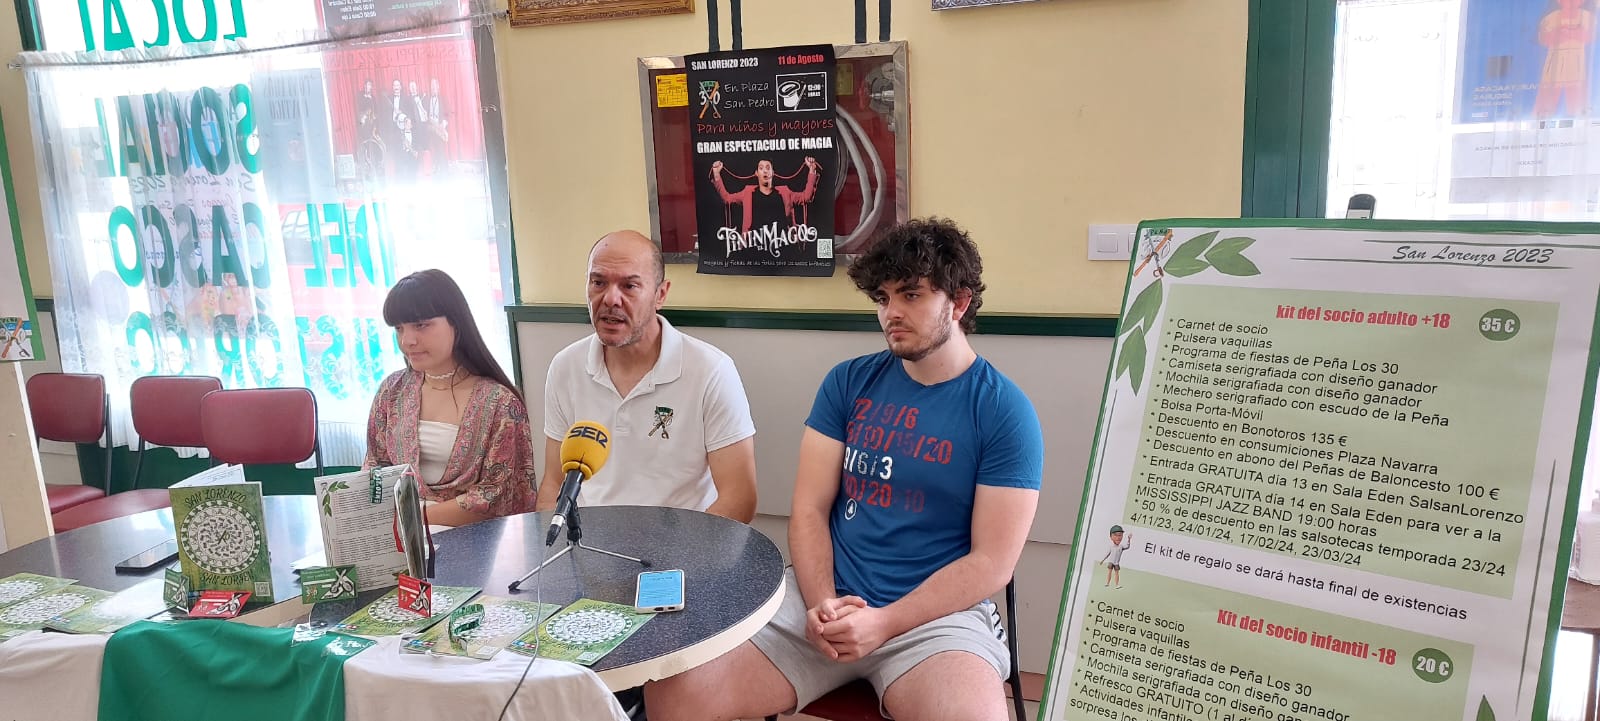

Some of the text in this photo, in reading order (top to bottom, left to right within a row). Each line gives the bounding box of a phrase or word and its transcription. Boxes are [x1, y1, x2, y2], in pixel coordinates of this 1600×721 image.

[691, 57, 759, 71] SAN LORENZO 2023
[778, 54, 825, 65] 11 de Agosto
[724, 83, 739, 93] En
[741, 82, 769, 92] Plaza
[724, 97, 775, 109] San Pedro
[696, 118, 834, 136] Para niños y mayores
[697, 136, 833, 154] GRAN ESPECTACULO DE MAGIA
[1393, 245, 1554, 266] San Lorenzo 2023
[1177, 318, 1268, 335] Carnet de socio
[1276, 304, 1451, 329] kit del socio adulto +18
[1481, 317, 1516, 334] 35 €
[1174, 332, 1273, 349] Pulsera vaquillas
[1171, 344, 1399, 375] Programa de fiestas de Peña Los 30
[1168, 358, 1438, 395] Camiseta serigrafiada con diseño ganador
[1160, 398, 1264, 421] Bolsa Porta-Móvil
[1163, 384, 1449, 427] Mechero serigrafiado con escudo de la Peña
[568, 426, 608, 448] SER
[1158, 412, 1348, 447] Descuento en Bonotoros 135 €
[1155, 426, 1438, 475] Descuento en consumiciones Plaza Navarra
[1153, 439, 1500, 501] Descuento en abono del Peñas de Baloncesto 100 €
[185, 492, 202, 508] SAN
[1150, 455, 1524, 524] Entrada GRATUITA día 13 en Sala Eden SalsanLorenzo
[1136, 485, 1377, 537] MISSISSIPPI JAZZ BAND 19:00 horas
[1130, 513, 1362, 566] 4/11/23, 24/01/24, 17/02/24, 23/03/24
[1142, 500, 1506, 577] 50 % de descuento en las salsotecas temporada 23/24
[1144, 542, 1468, 620] El kit de regalo se dará hasta final de existencias
[1217, 609, 1397, 666] Kit del socio infantil -18
[1416, 655, 1450, 677] 20 €
[1080, 684, 1144, 712] Actividades
[1084, 670, 1133, 694] Refresco
[1136, 686, 1204, 715] GRATUITO
[1087, 656, 1273, 720] Mochila serigrafiada con diseño
[1070, 698, 1118, 720] sorpresa
